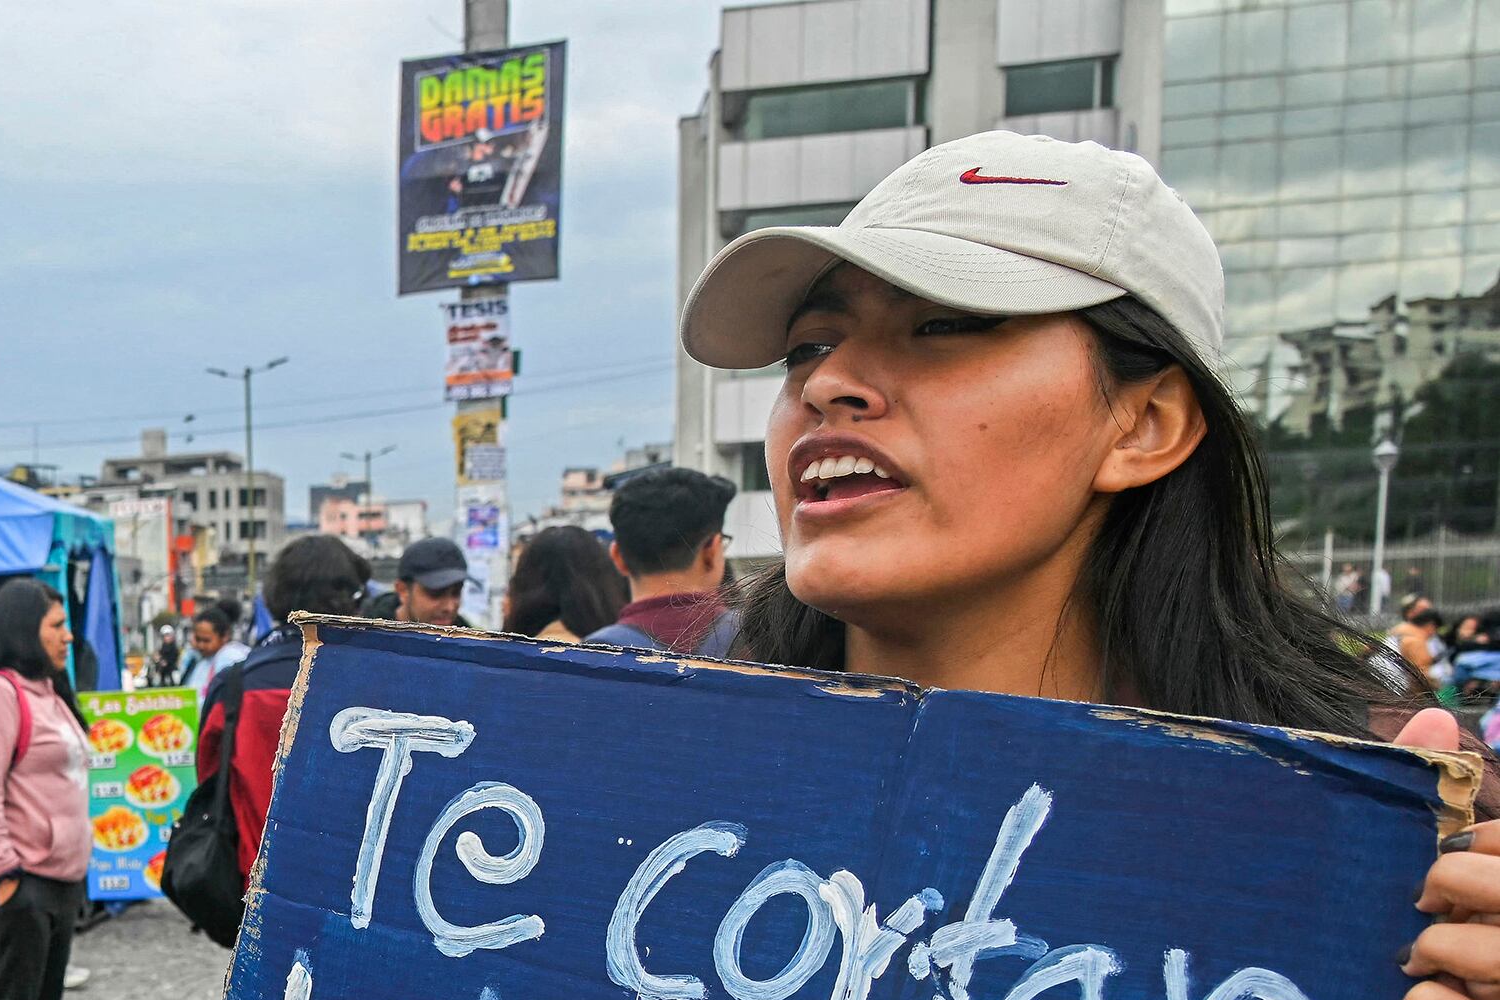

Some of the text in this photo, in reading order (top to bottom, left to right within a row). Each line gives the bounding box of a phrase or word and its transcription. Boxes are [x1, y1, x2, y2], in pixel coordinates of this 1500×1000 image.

[419, 52, 546, 111] DAMAS
[420, 86, 546, 143] GRATIS
[329, 705, 546, 959] Te
